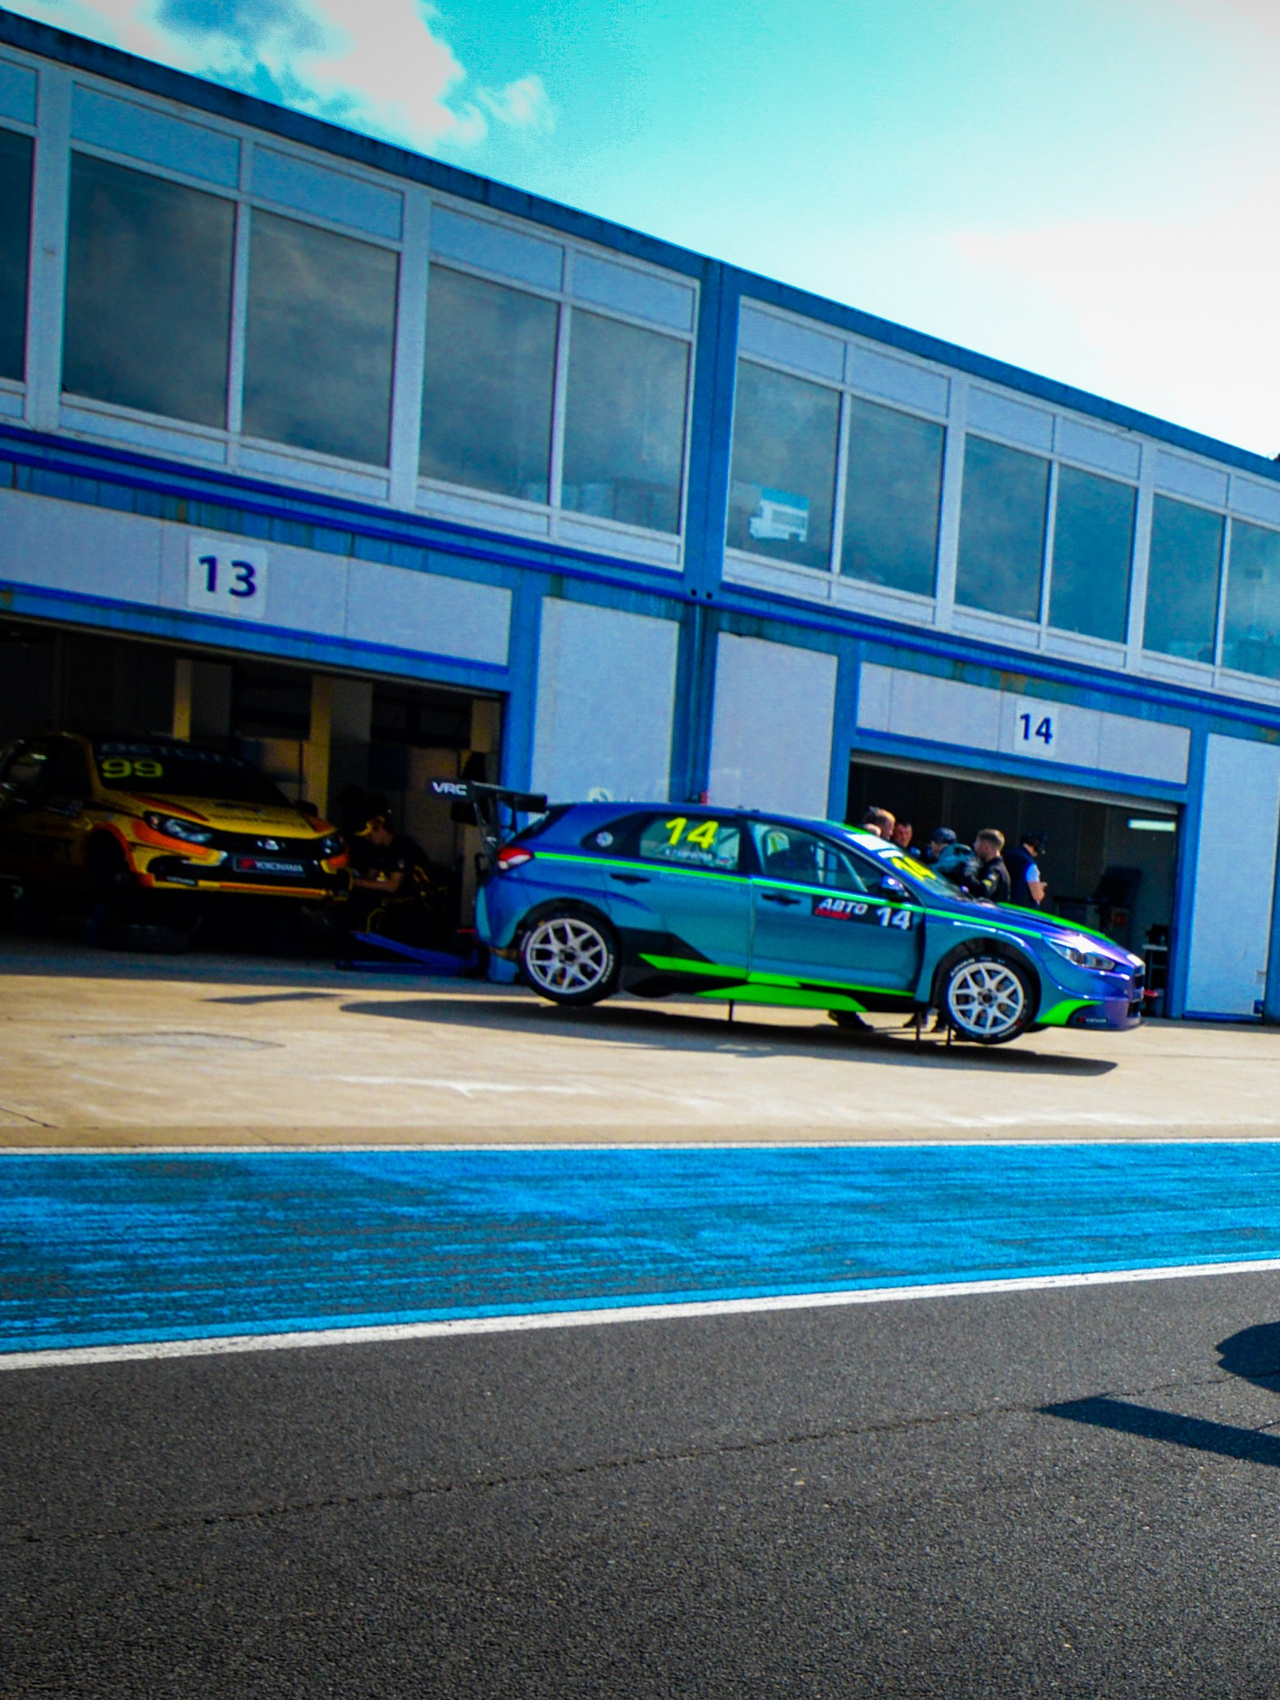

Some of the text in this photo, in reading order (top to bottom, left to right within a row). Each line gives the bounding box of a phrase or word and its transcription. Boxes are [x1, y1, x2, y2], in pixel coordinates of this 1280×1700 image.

[198, 554, 257, 598] 13
[1020, 713, 1053, 745] 14
[101, 758, 163, 779] 99
[432, 781, 468, 796] VRC
[665, 817, 719, 849] 14
[876, 906, 911, 930] 14
